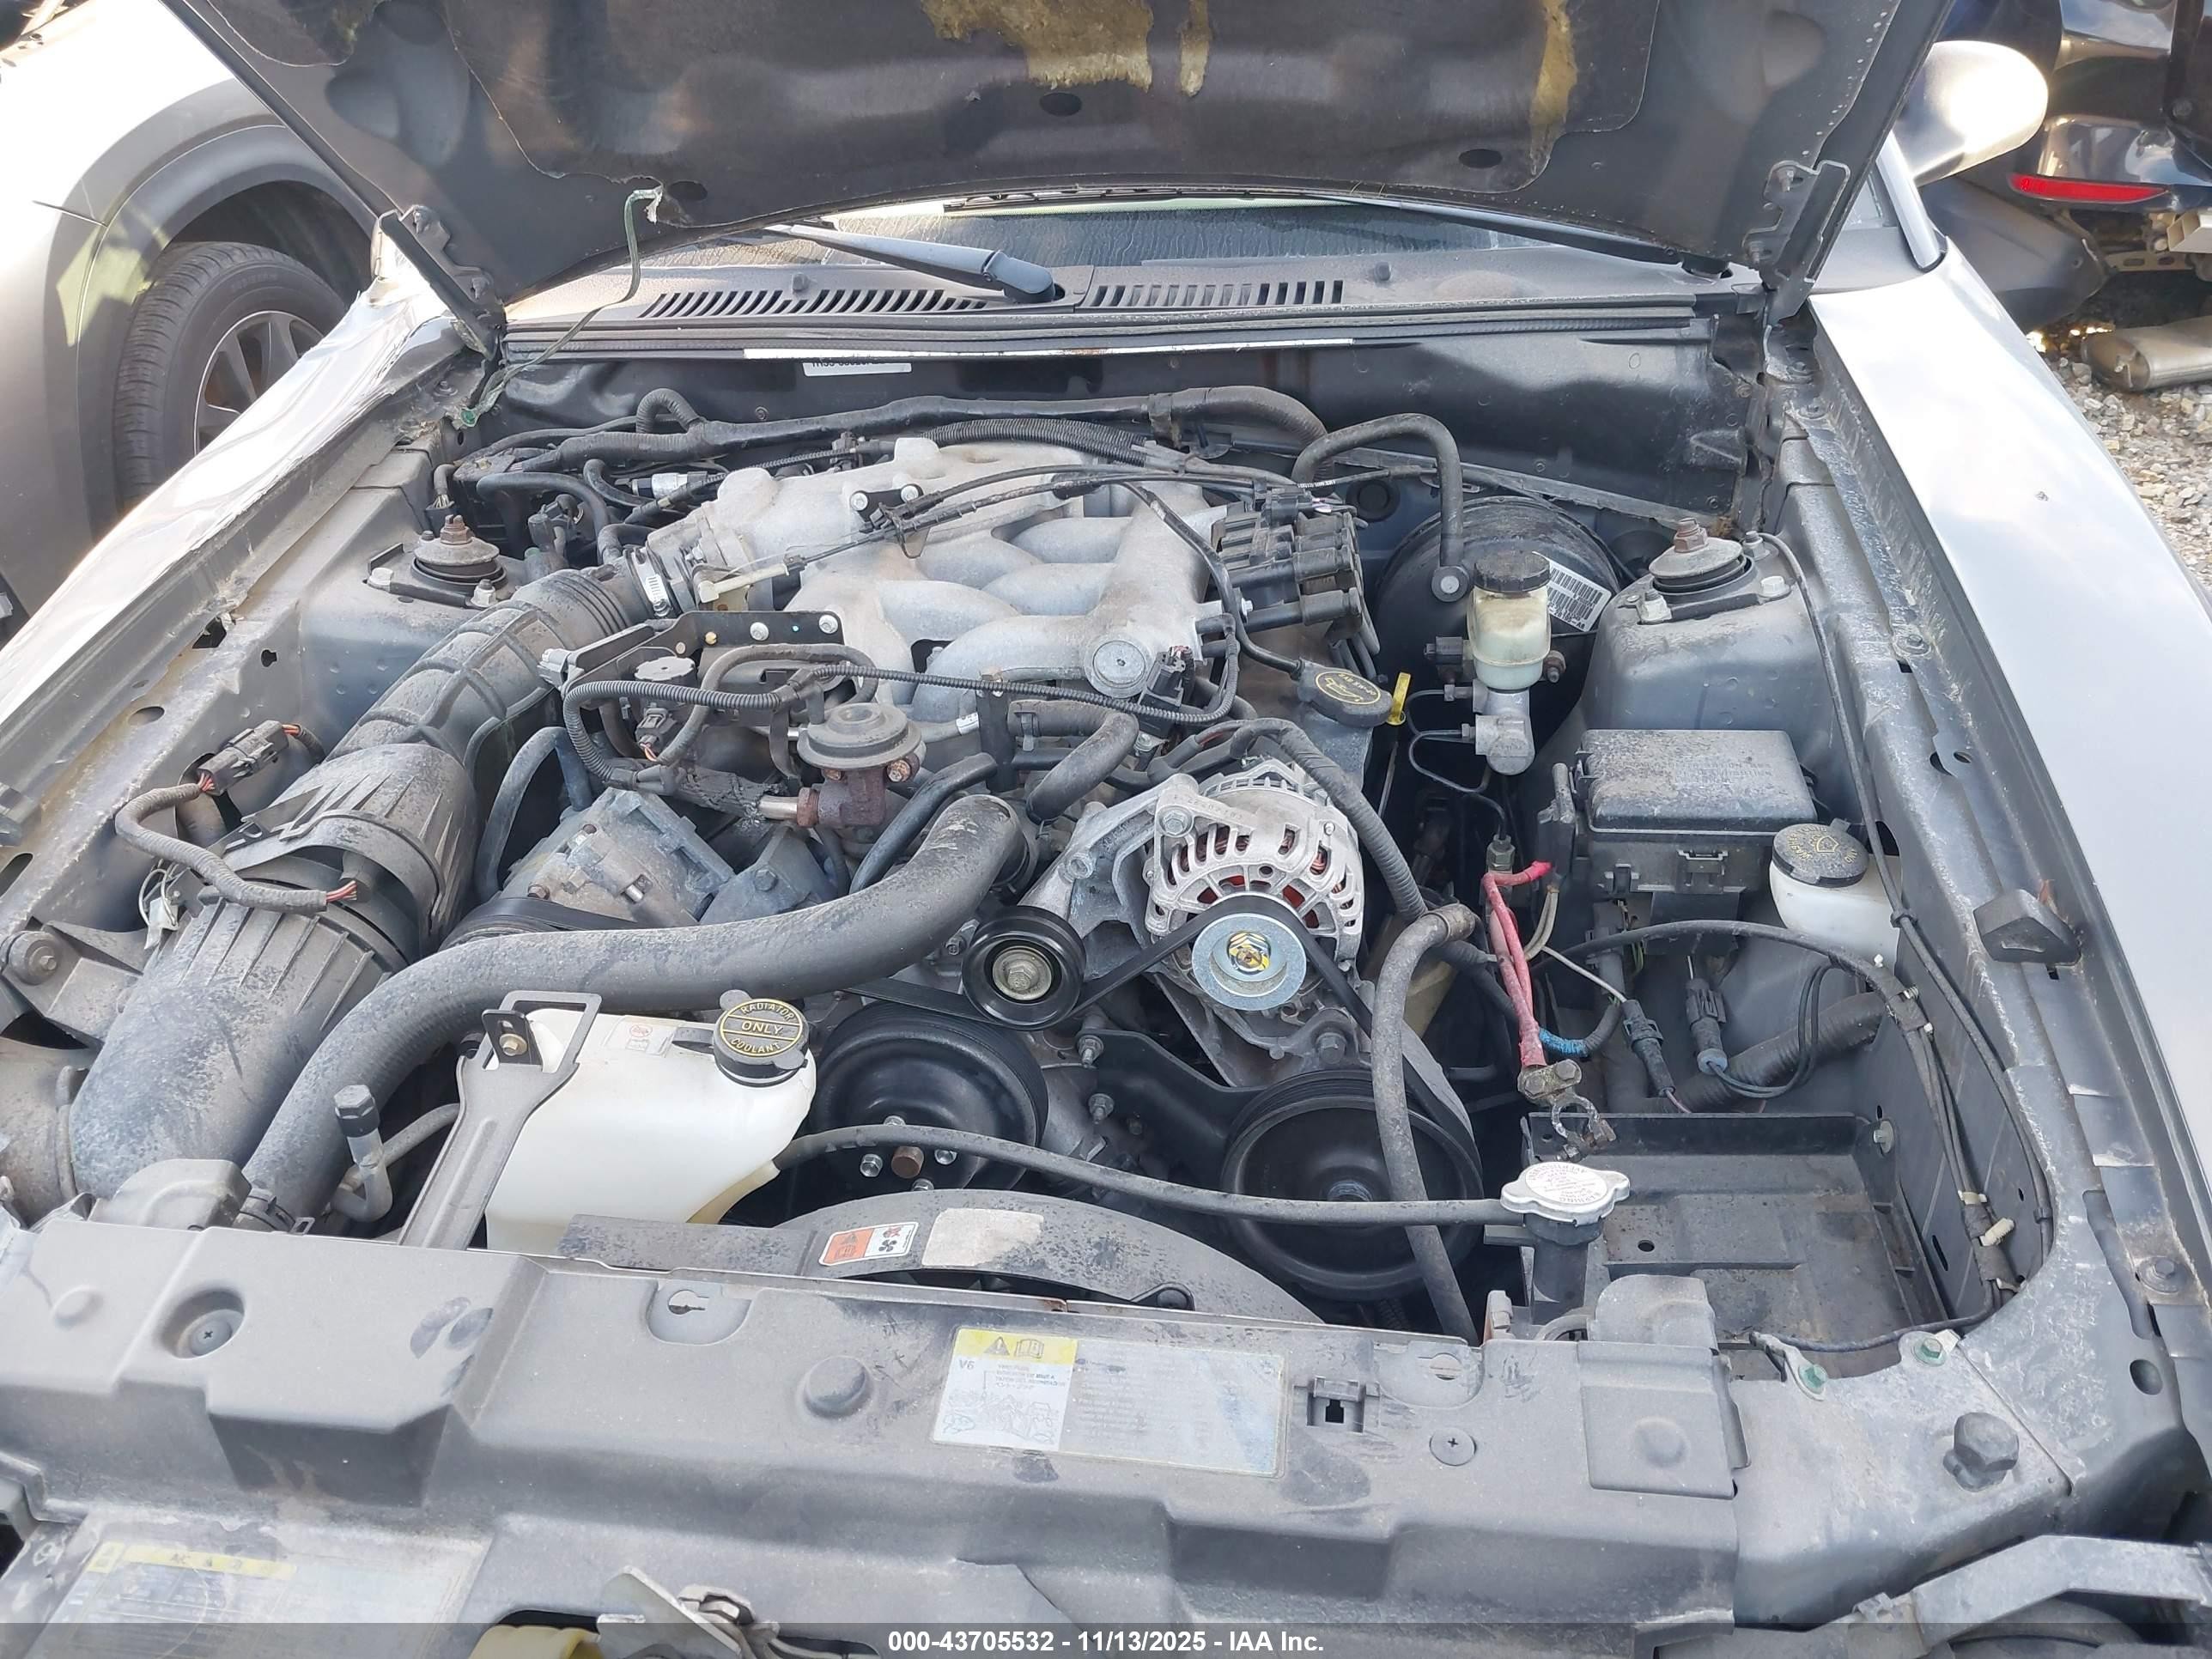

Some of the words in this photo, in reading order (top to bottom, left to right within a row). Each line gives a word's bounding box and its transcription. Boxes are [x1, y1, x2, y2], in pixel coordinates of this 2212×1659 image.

[740, 1002, 796, 1022] RADIATOR
[742, 1020, 783, 1035] ONLY
[731, 1037, 782, 1054] COOLANT
[958, 1359, 975, 1370] V6
